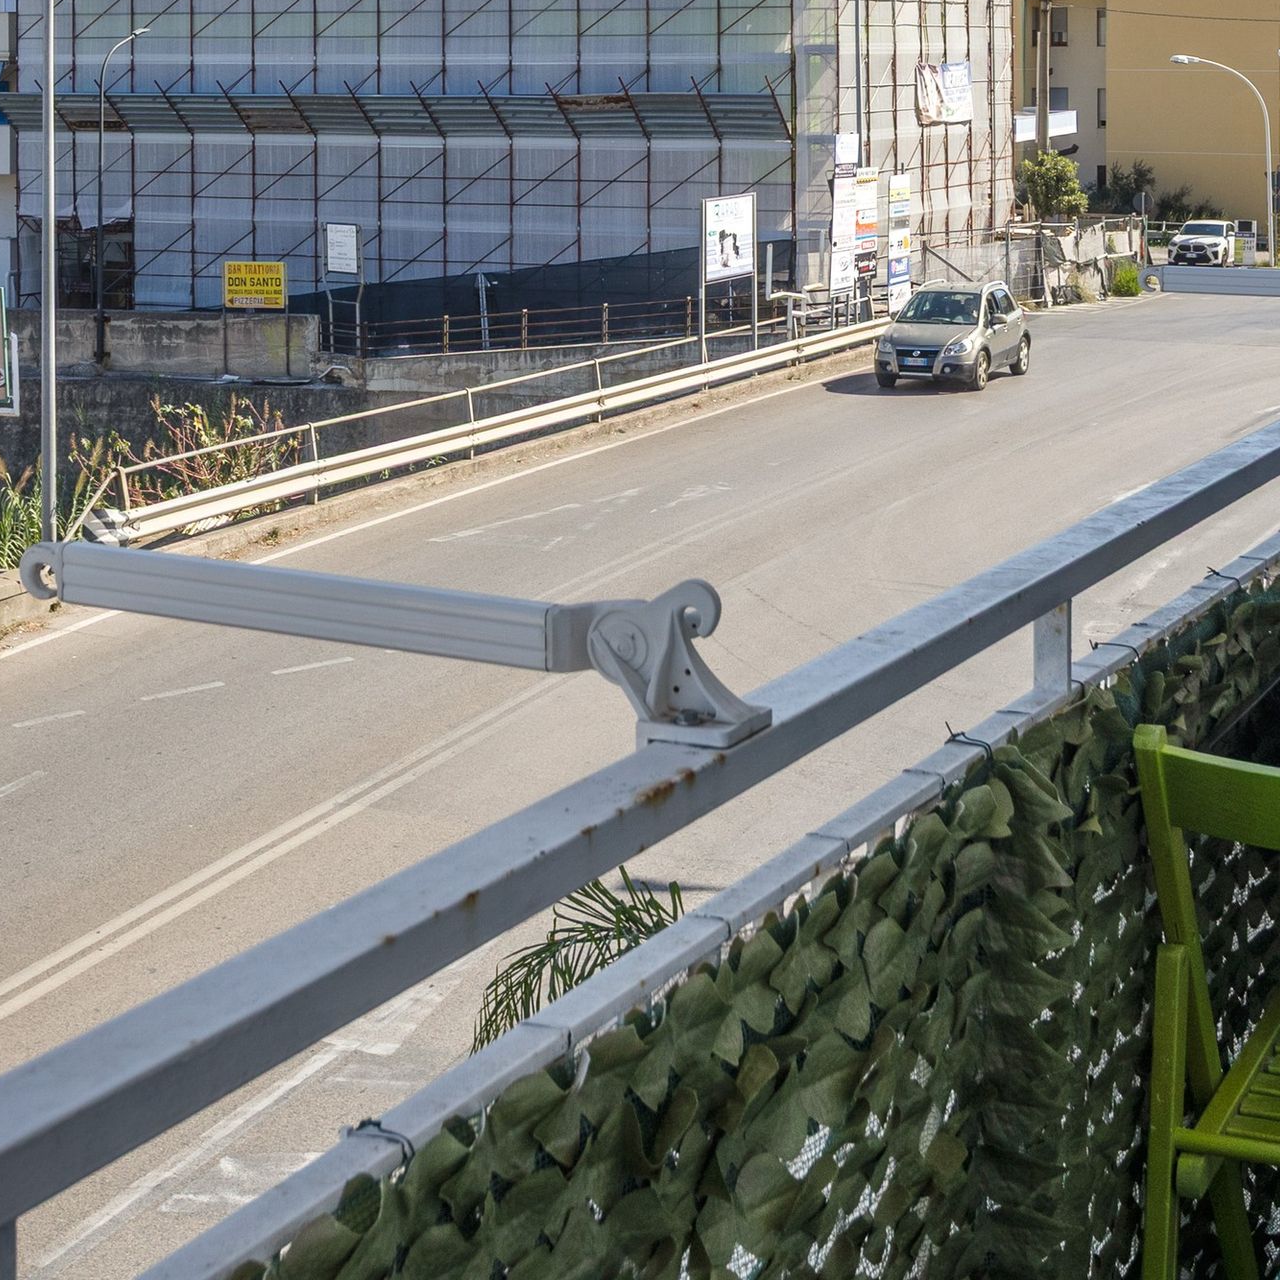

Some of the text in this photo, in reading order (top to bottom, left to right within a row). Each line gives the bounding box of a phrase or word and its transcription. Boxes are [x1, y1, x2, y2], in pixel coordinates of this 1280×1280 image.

[228, 277, 282, 287] DON SANTO
[234, 297, 263, 305] PIZZERIA
